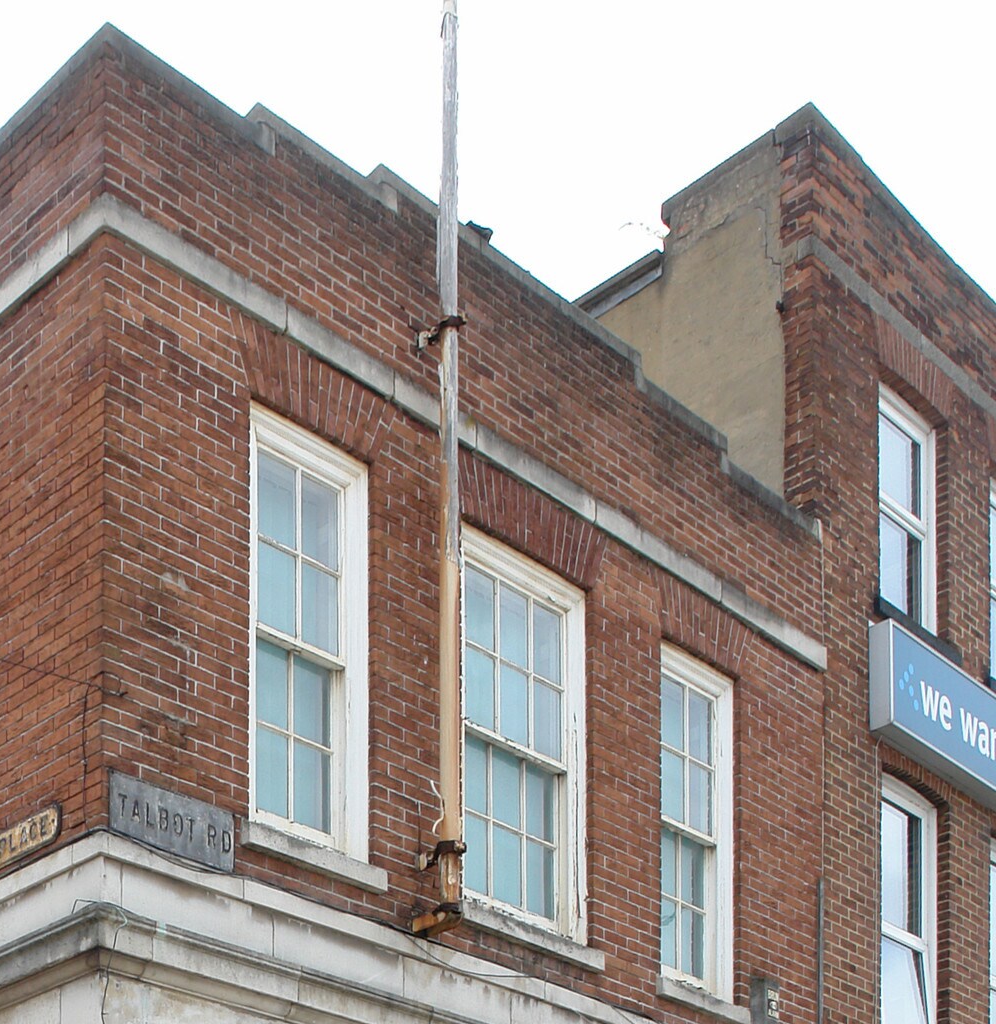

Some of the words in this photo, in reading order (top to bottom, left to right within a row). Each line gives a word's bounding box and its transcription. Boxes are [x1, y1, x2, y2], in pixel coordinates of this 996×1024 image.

[920, 680, 952, 731] we
[118, 793, 195, 842] TALBOT
[208, 823, 232, 853] RD
